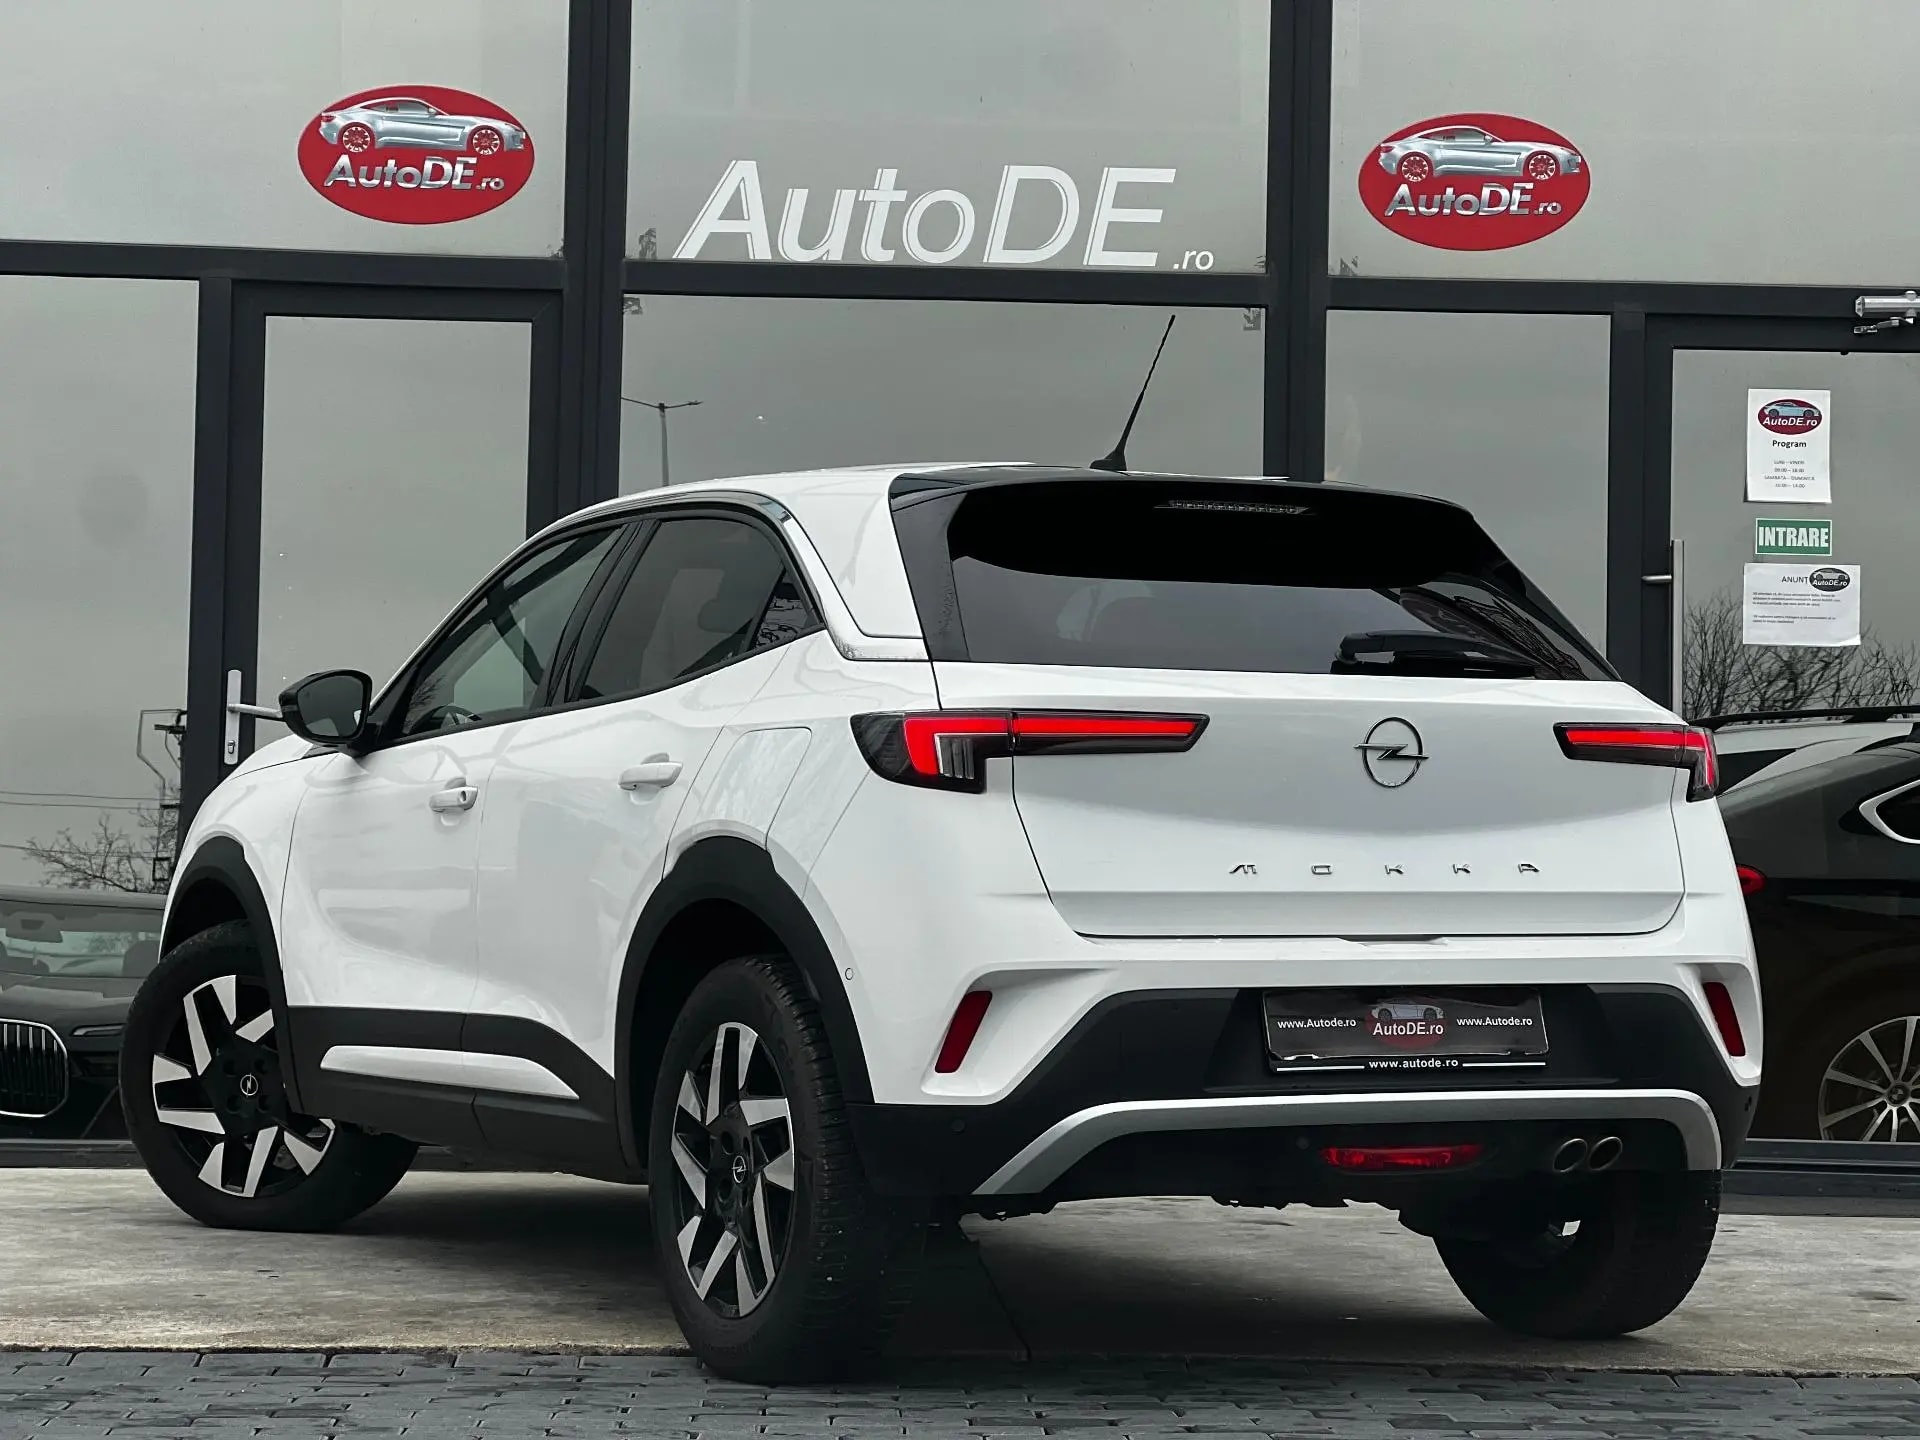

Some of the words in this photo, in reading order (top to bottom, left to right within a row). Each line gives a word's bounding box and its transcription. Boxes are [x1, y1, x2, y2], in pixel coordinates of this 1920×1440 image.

[1762, 416, 1818, 427] AutoDE.ro
[1772, 439, 1807, 449] Program
[1758, 526, 1829, 548] INTRARE
[1229, 864, 1540, 875] MOKKA
[1277, 1017, 1357, 1029] www.Autode.ro
[1456, 1015, 1533, 1027] www.Autode.ro
[1372, 1021, 1444, 1037] AutoDE.ro
[1368, 1057, 1459, 1069] www.autode.ro
